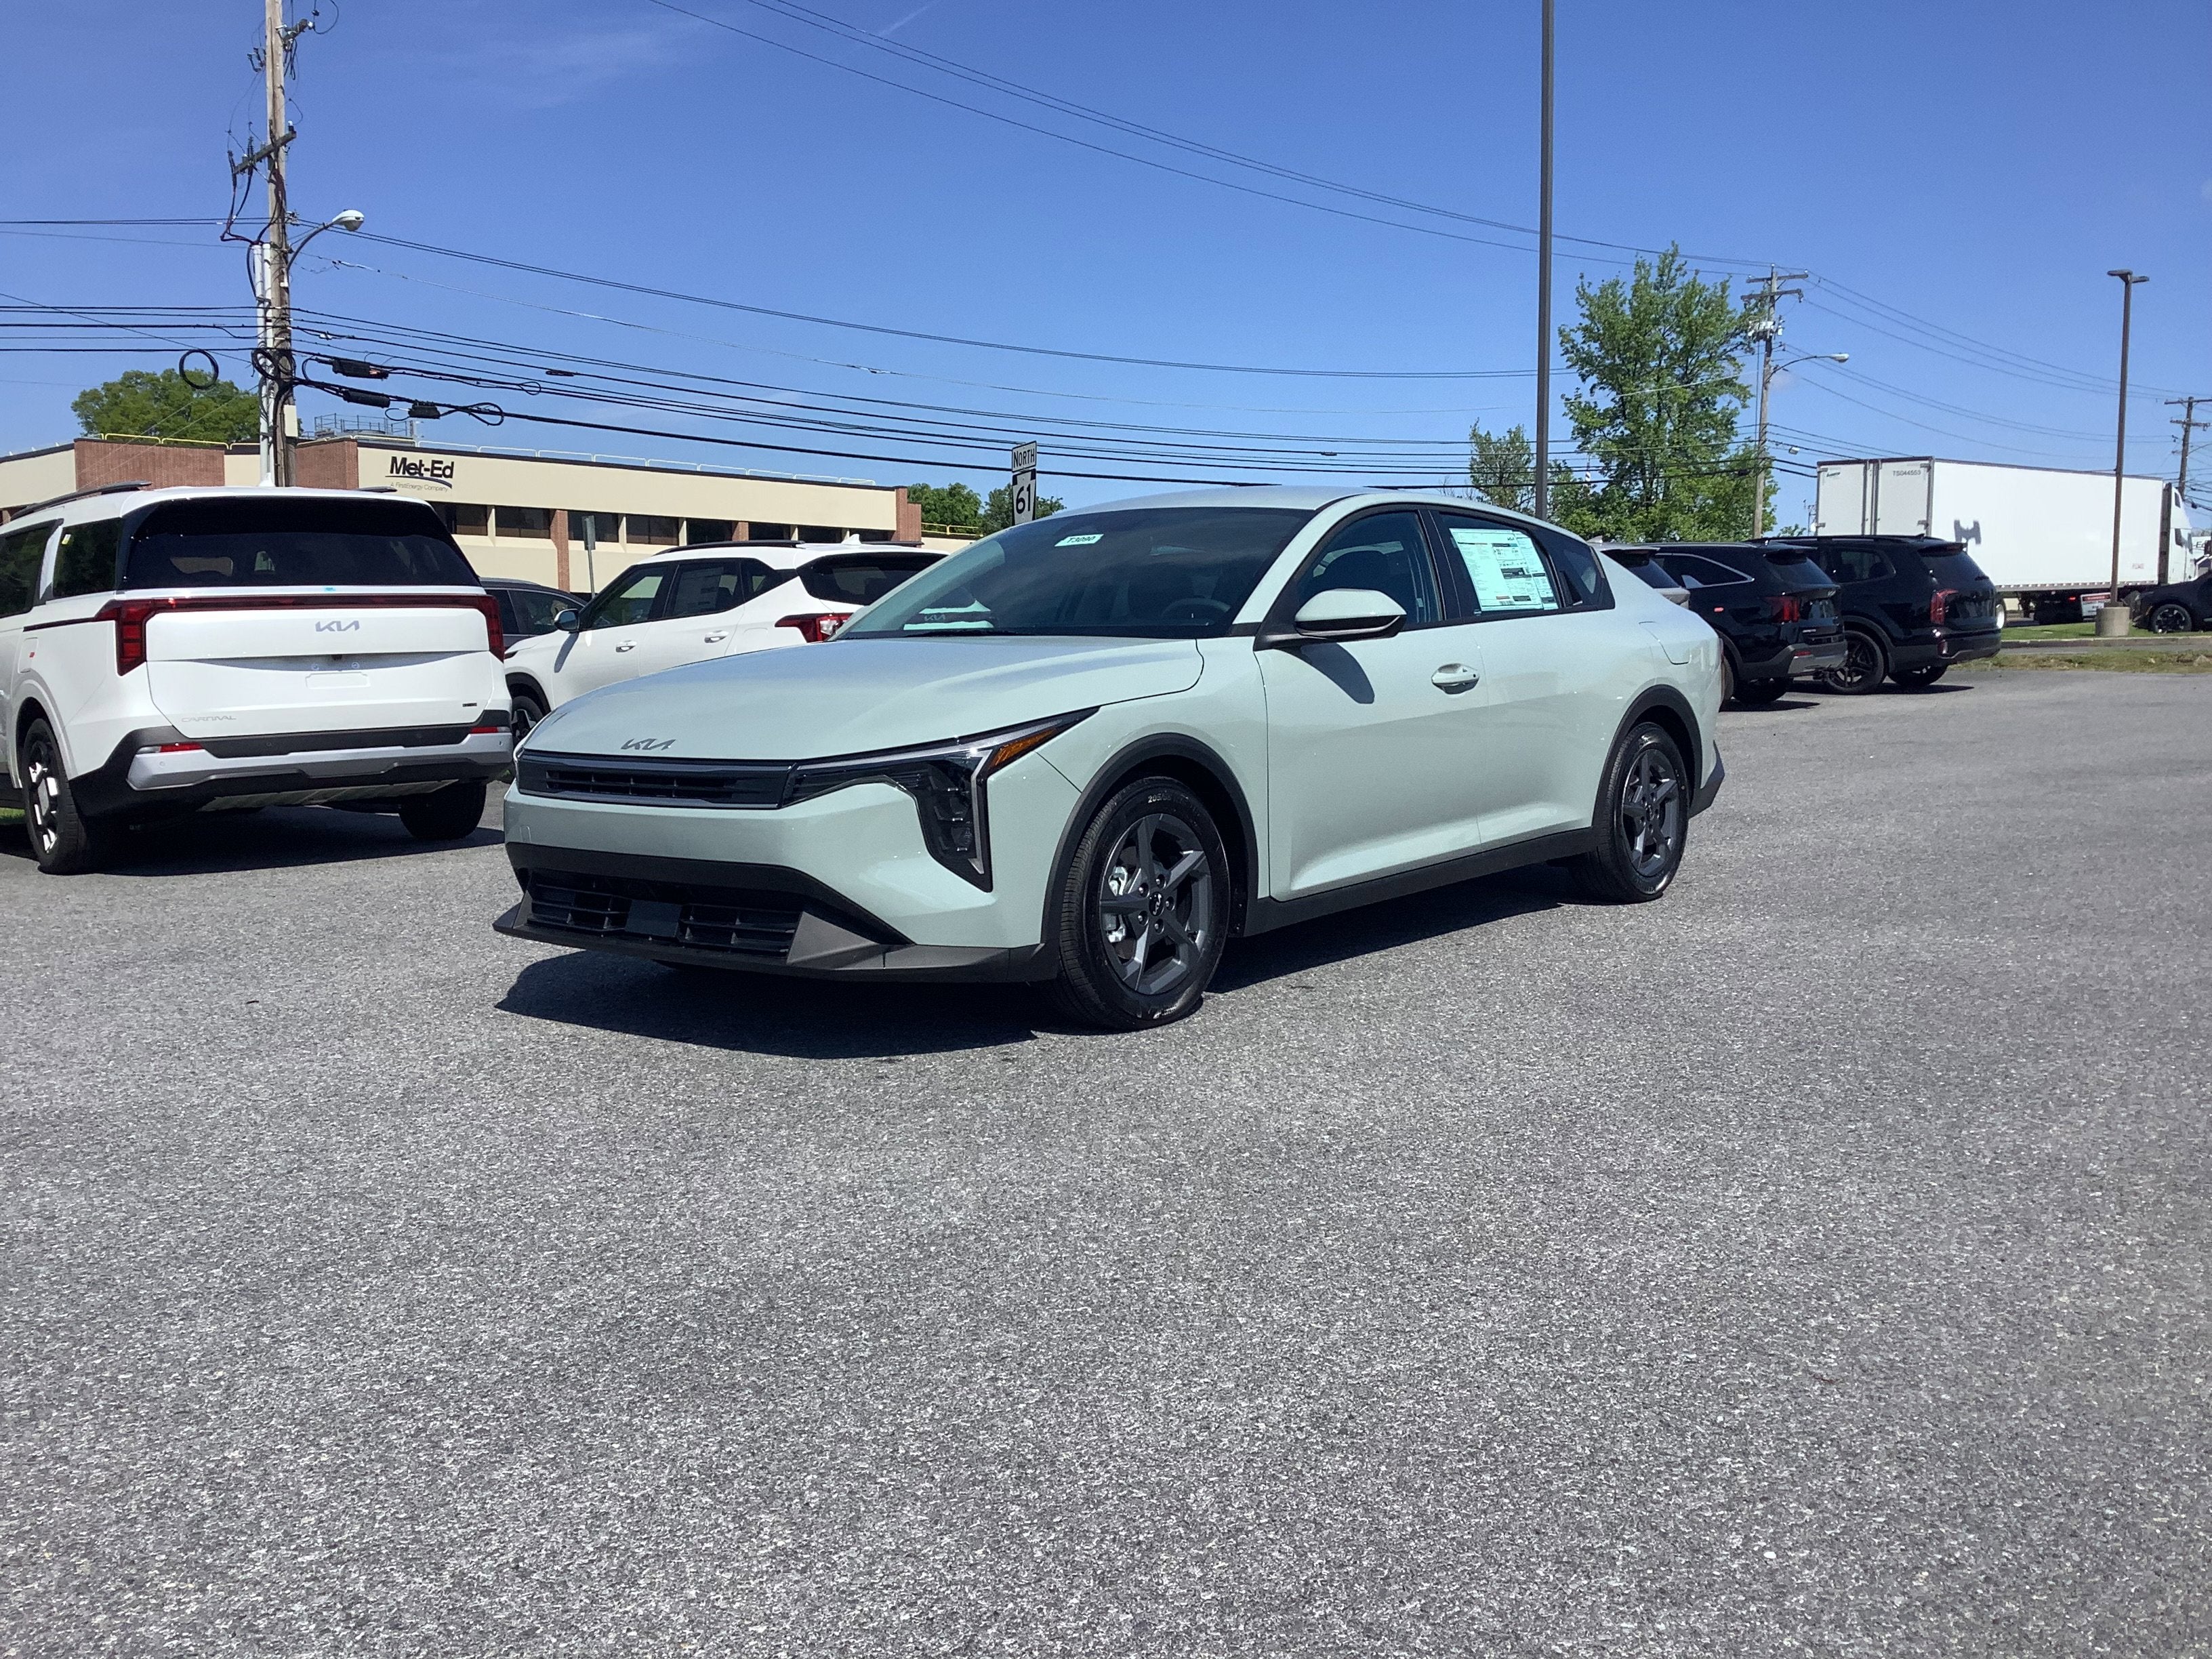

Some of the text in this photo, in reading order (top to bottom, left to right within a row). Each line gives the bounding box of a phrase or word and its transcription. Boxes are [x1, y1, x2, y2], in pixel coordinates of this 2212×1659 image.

[1013, 448, 1035, 468] NORTH
[390, 456, 455, 479] Met-Ed
[424, 484, 449, 492] Company
[1016, 484, 1031, 514] 61
[315, 620, 360, 632] KIA
[620, 738, 676, 751] KIA
